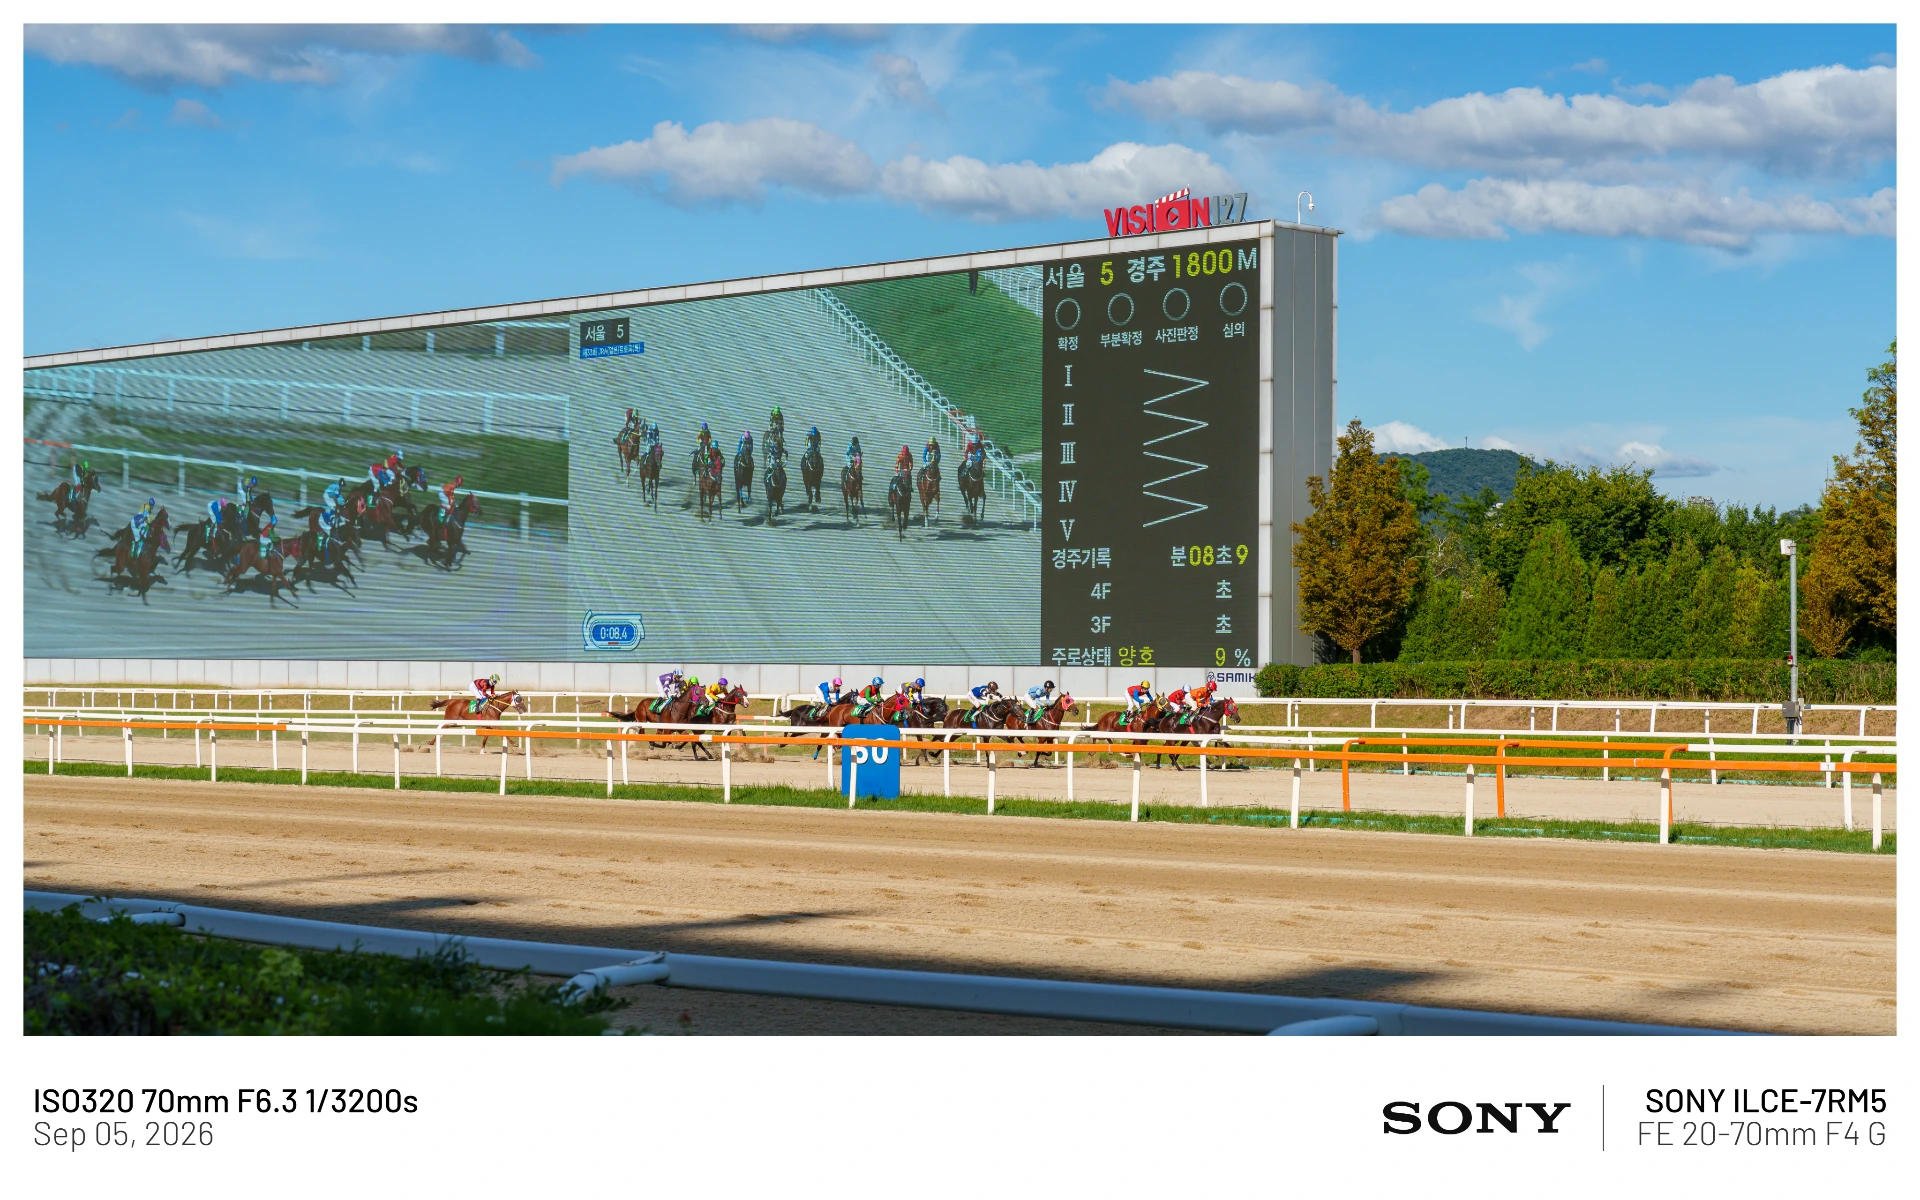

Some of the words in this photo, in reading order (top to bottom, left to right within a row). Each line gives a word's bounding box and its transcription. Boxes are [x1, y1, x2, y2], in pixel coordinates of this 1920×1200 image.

[1046, 263, 1085, 289] 서울
[1100, 262, 1114, 286] 5
[1127, 255, 1166, 283] 경주
[585, 324, 606, 341] 서울
[616, 324, 624, 339] 5
[1100, 331, 1143, 348] 부분확정
[1155, 325, 1199, 344] 사진판정
[1223, 321, 1245, 338] 심의
[1057, 335, 1079, 351] 확정
[1060, 519, 1075, 541] V
[1051, 548, 1112, 569] 경주기록
[1090, 583, 1112, 600] 4F
[1215, 579, 1233, 599] 초
[600, 626, 628, 640] 0:08.4
[1090, 616, 1112, 634] 3F
[1215, 613, 1233, 634] 초
[1051, 647, 1112, 667] 주로상태
[1118, 645, 1156, 667] 양호
[1215, 647, 1226, 667] 9
